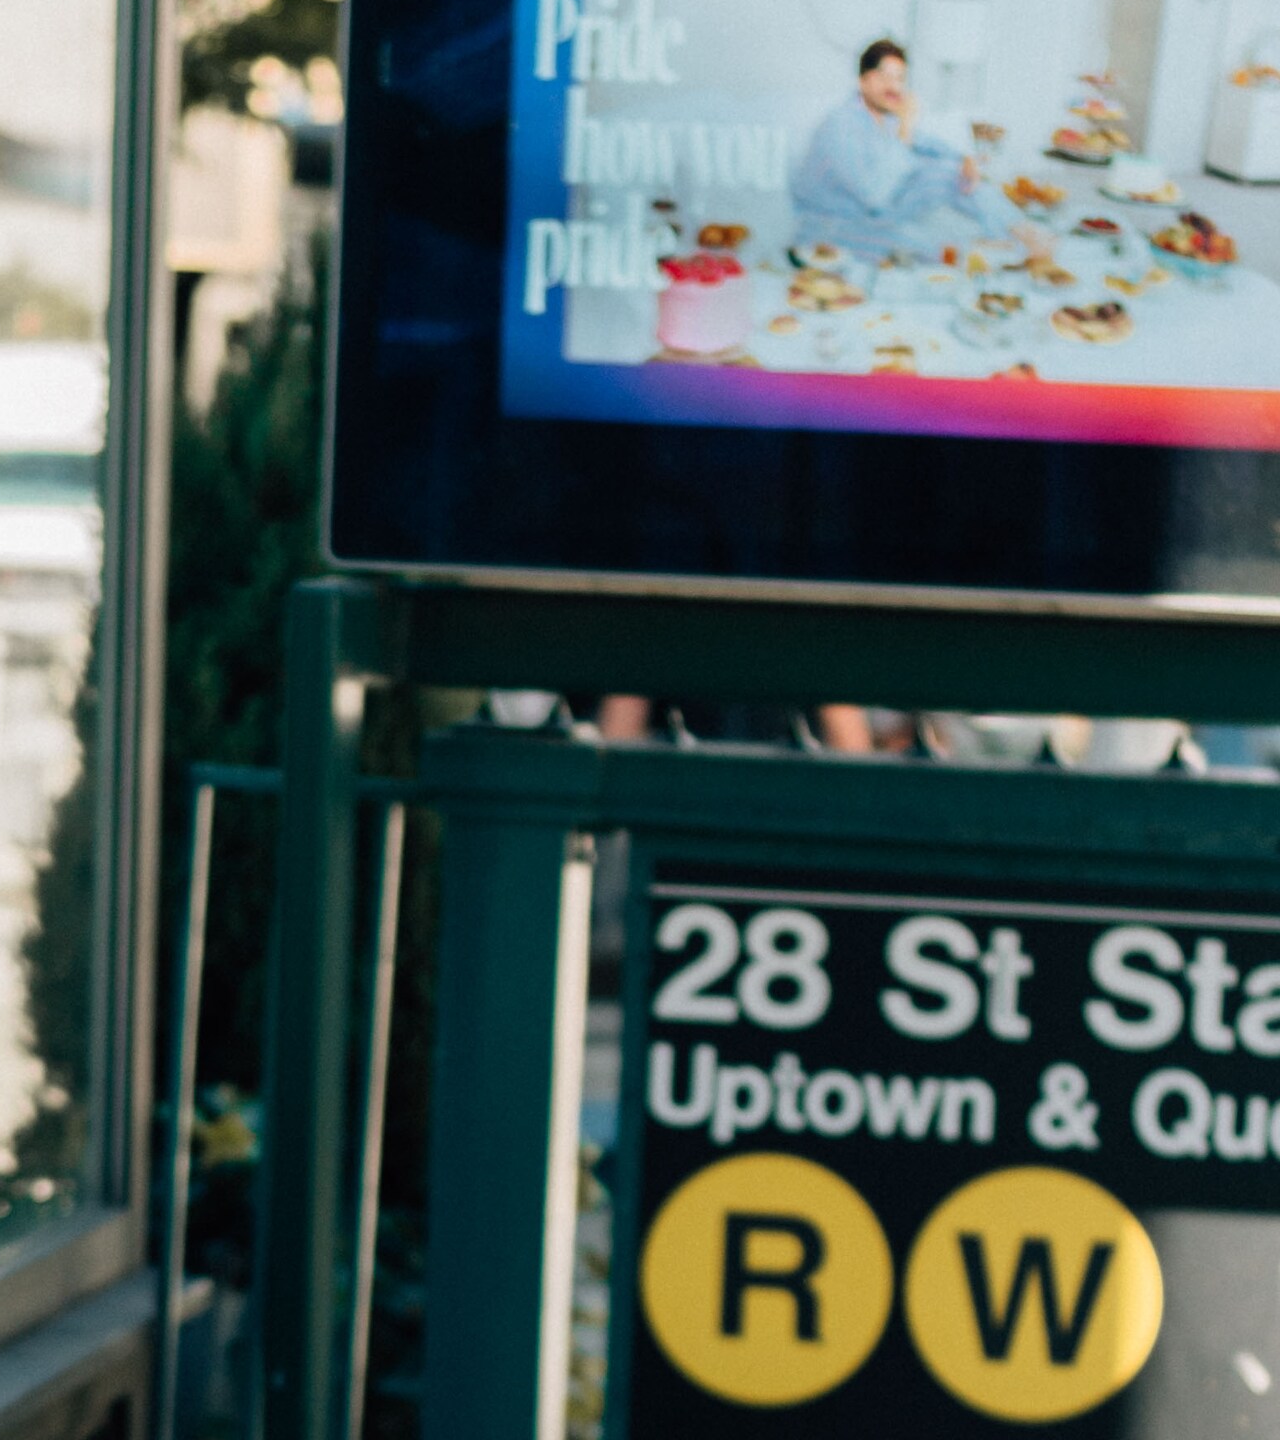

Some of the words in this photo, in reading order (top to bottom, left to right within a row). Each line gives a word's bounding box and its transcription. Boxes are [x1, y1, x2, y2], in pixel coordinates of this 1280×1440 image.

[524, 192, 678, 315] pride
[652, 903, 831, 1030] 28
[880, 915, 1034, 1041] St
[648, 1041, 996, 1145] Uptown
[1027, 1063, 1100, 1150] &
[719, 1208, 826, 1344] R
[958, 1230, 1116, 1368] W
